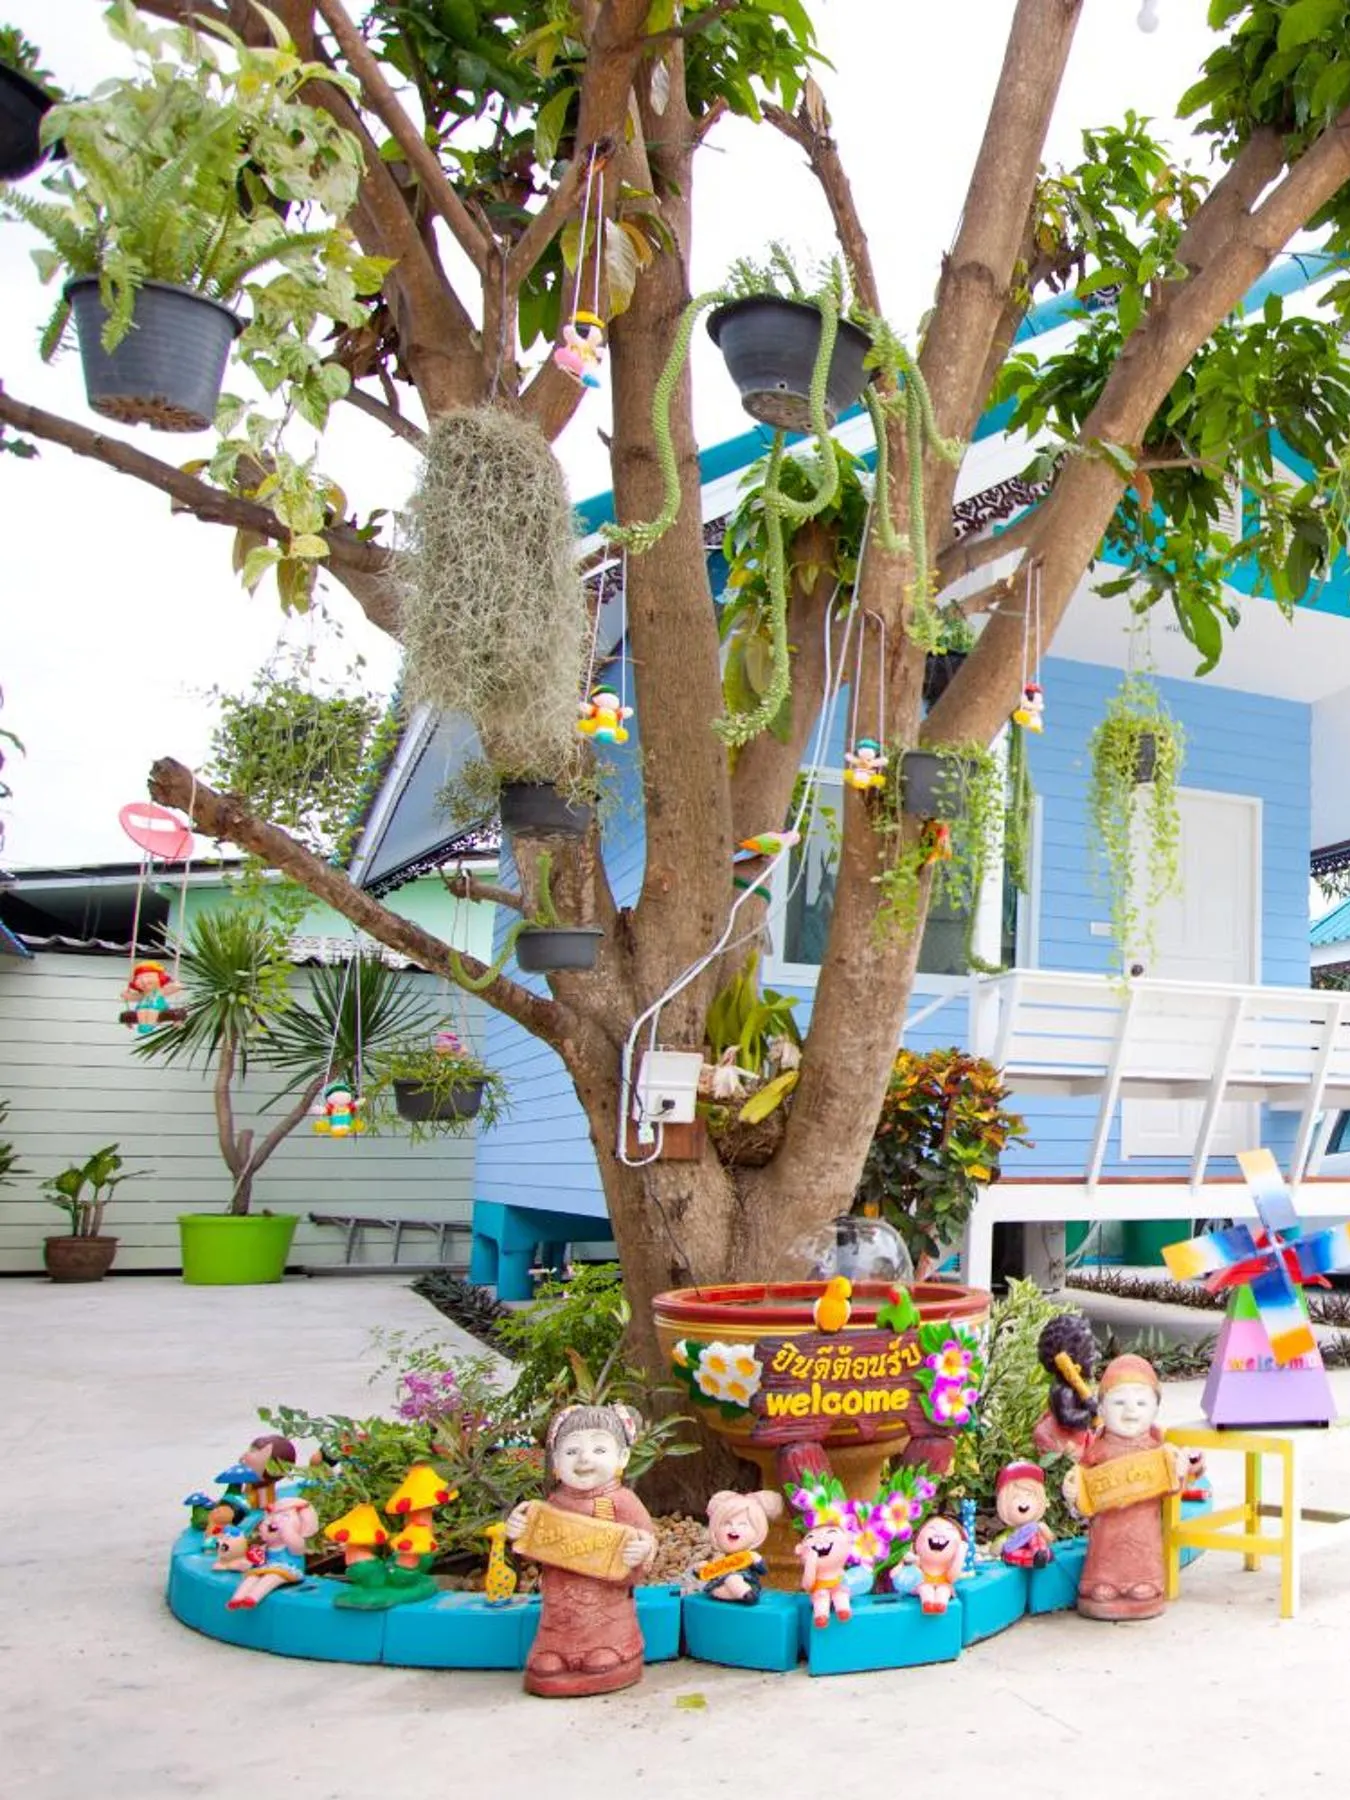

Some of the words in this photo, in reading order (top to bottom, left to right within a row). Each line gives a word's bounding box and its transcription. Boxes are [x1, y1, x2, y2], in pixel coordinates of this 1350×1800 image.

[771, 1336, 922, 1381] ยินดีต้อนรับ
[766, 1381, 910, 1417] welcome
